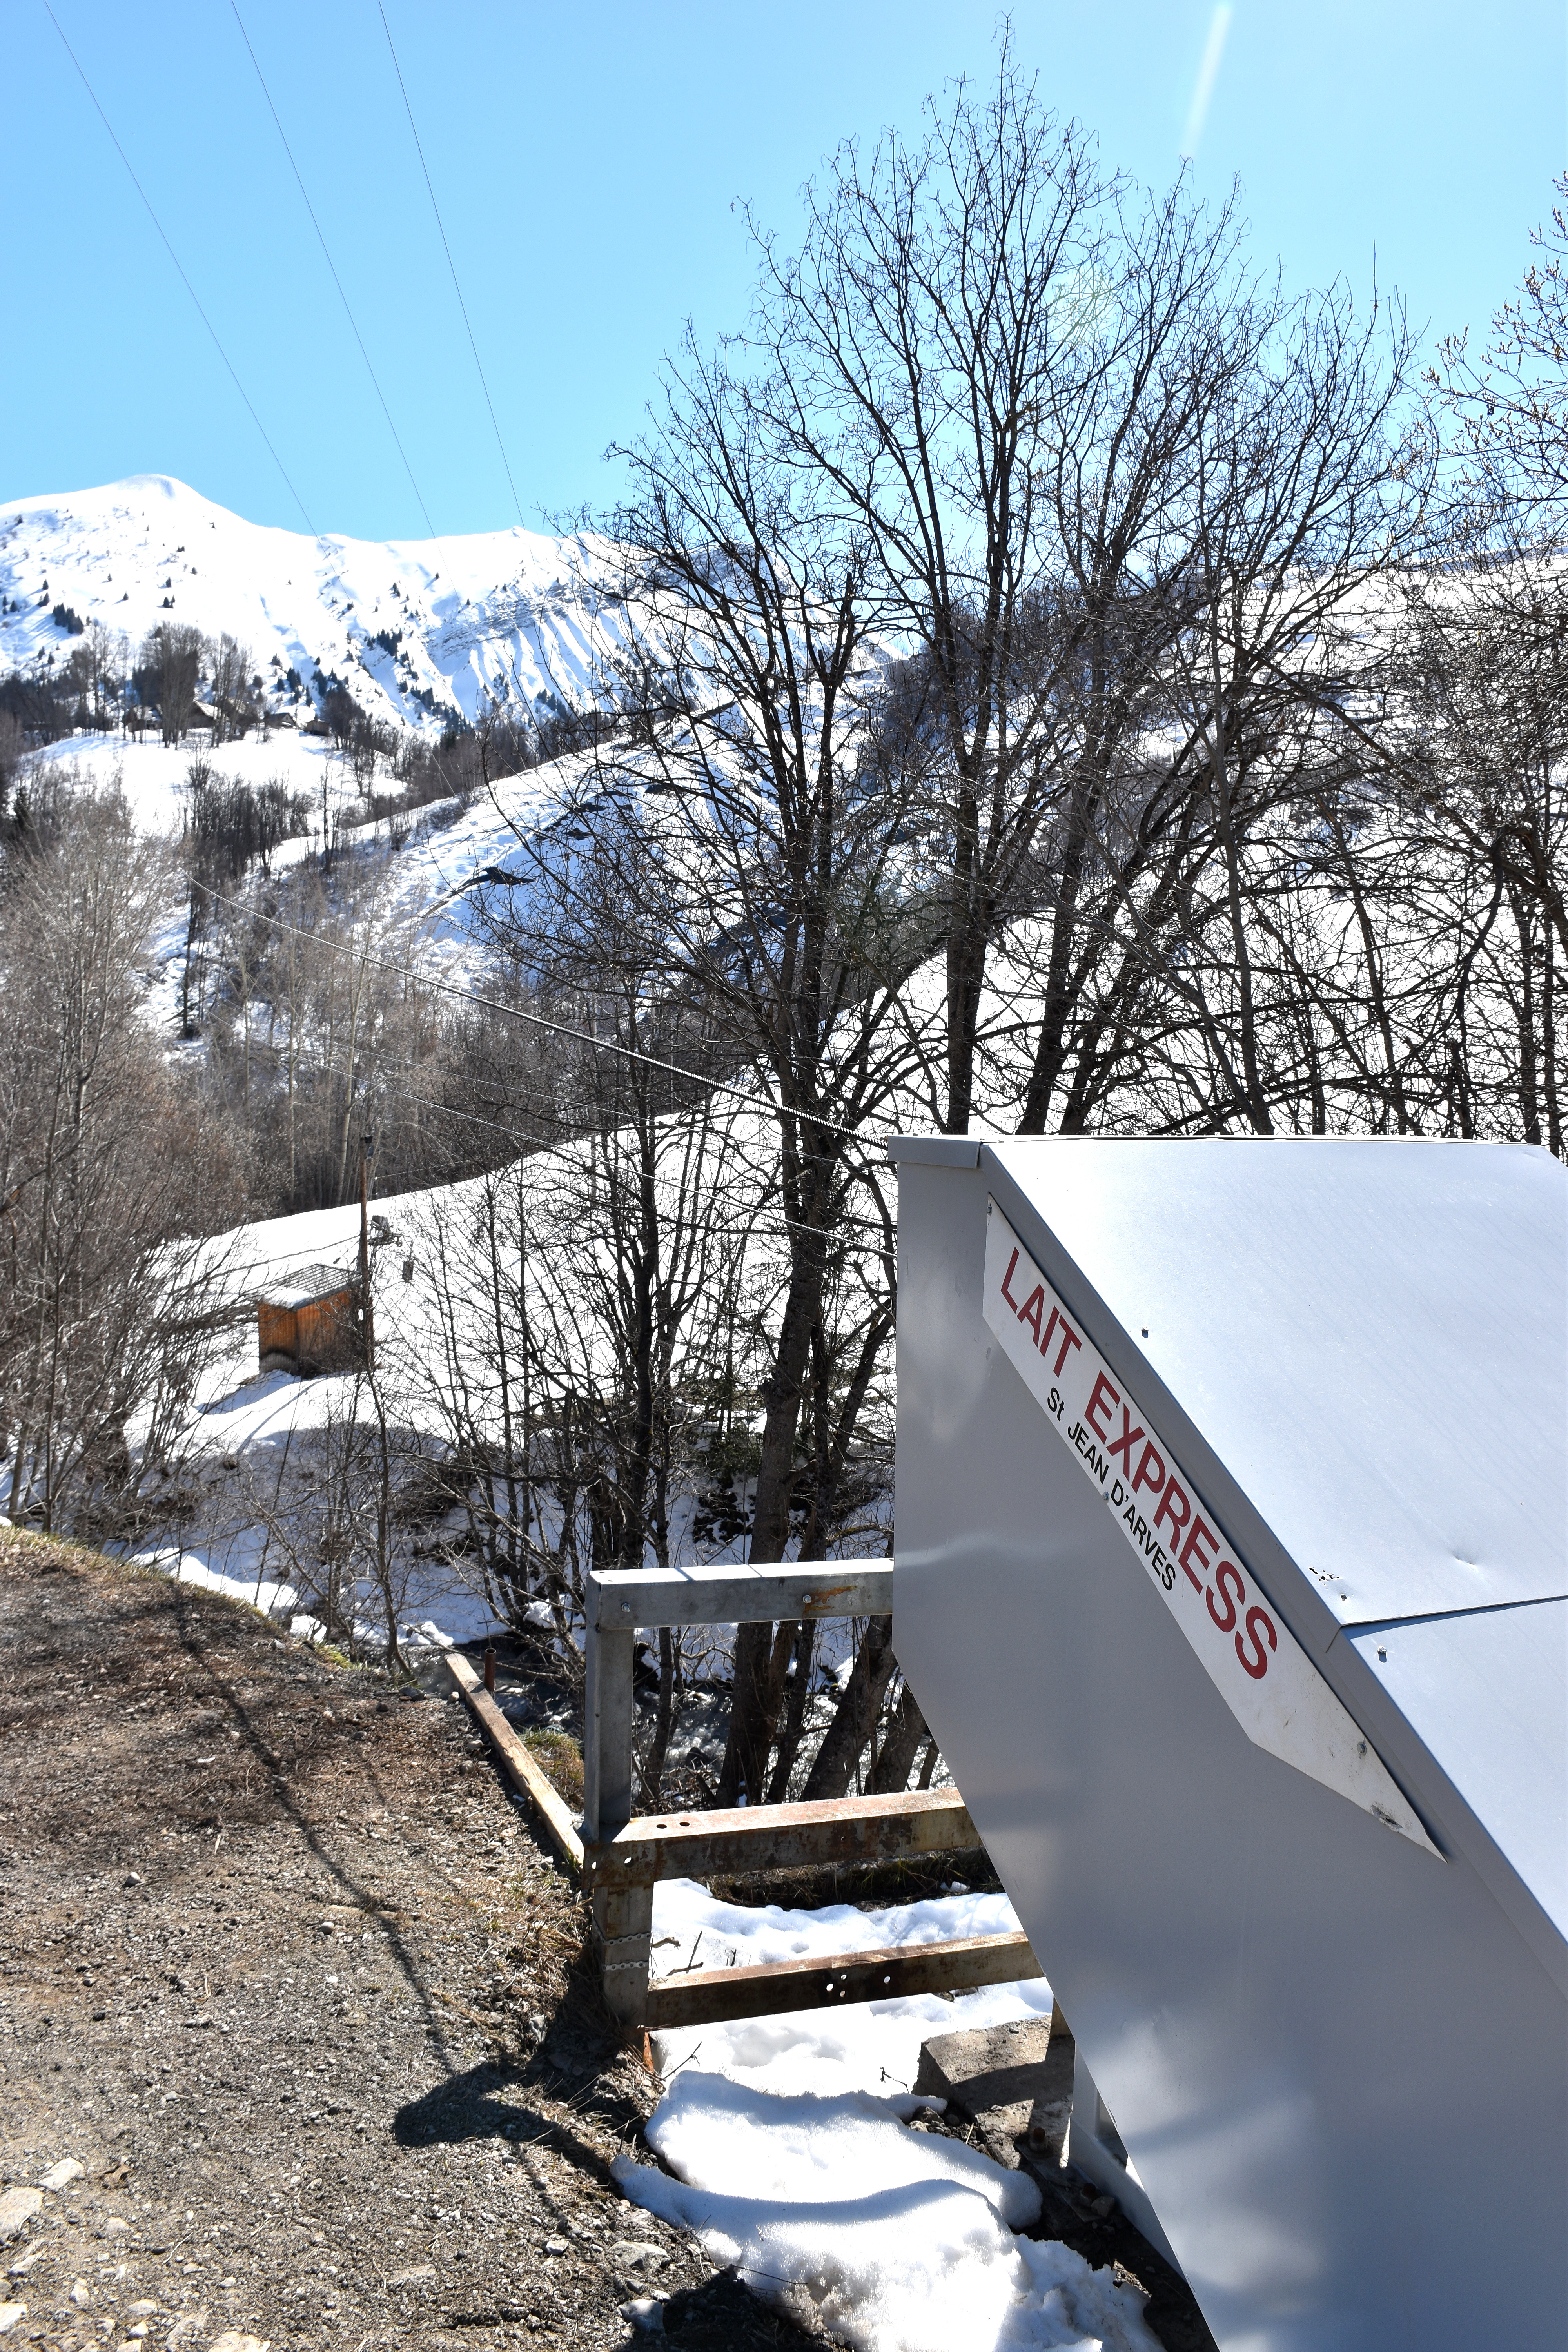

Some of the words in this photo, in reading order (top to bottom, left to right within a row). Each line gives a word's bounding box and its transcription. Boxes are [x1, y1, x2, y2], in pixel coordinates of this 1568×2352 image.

[1000, 1246, 1082, 1378] LAIT
[1083, 1370, 1277, 1680] EXPRESS
[1047, 1387, 1065, 1422] St
[1067, 1421, 1109, 1485] JEAN
[1110, 1478, 1176, 1592] D'ARVES
